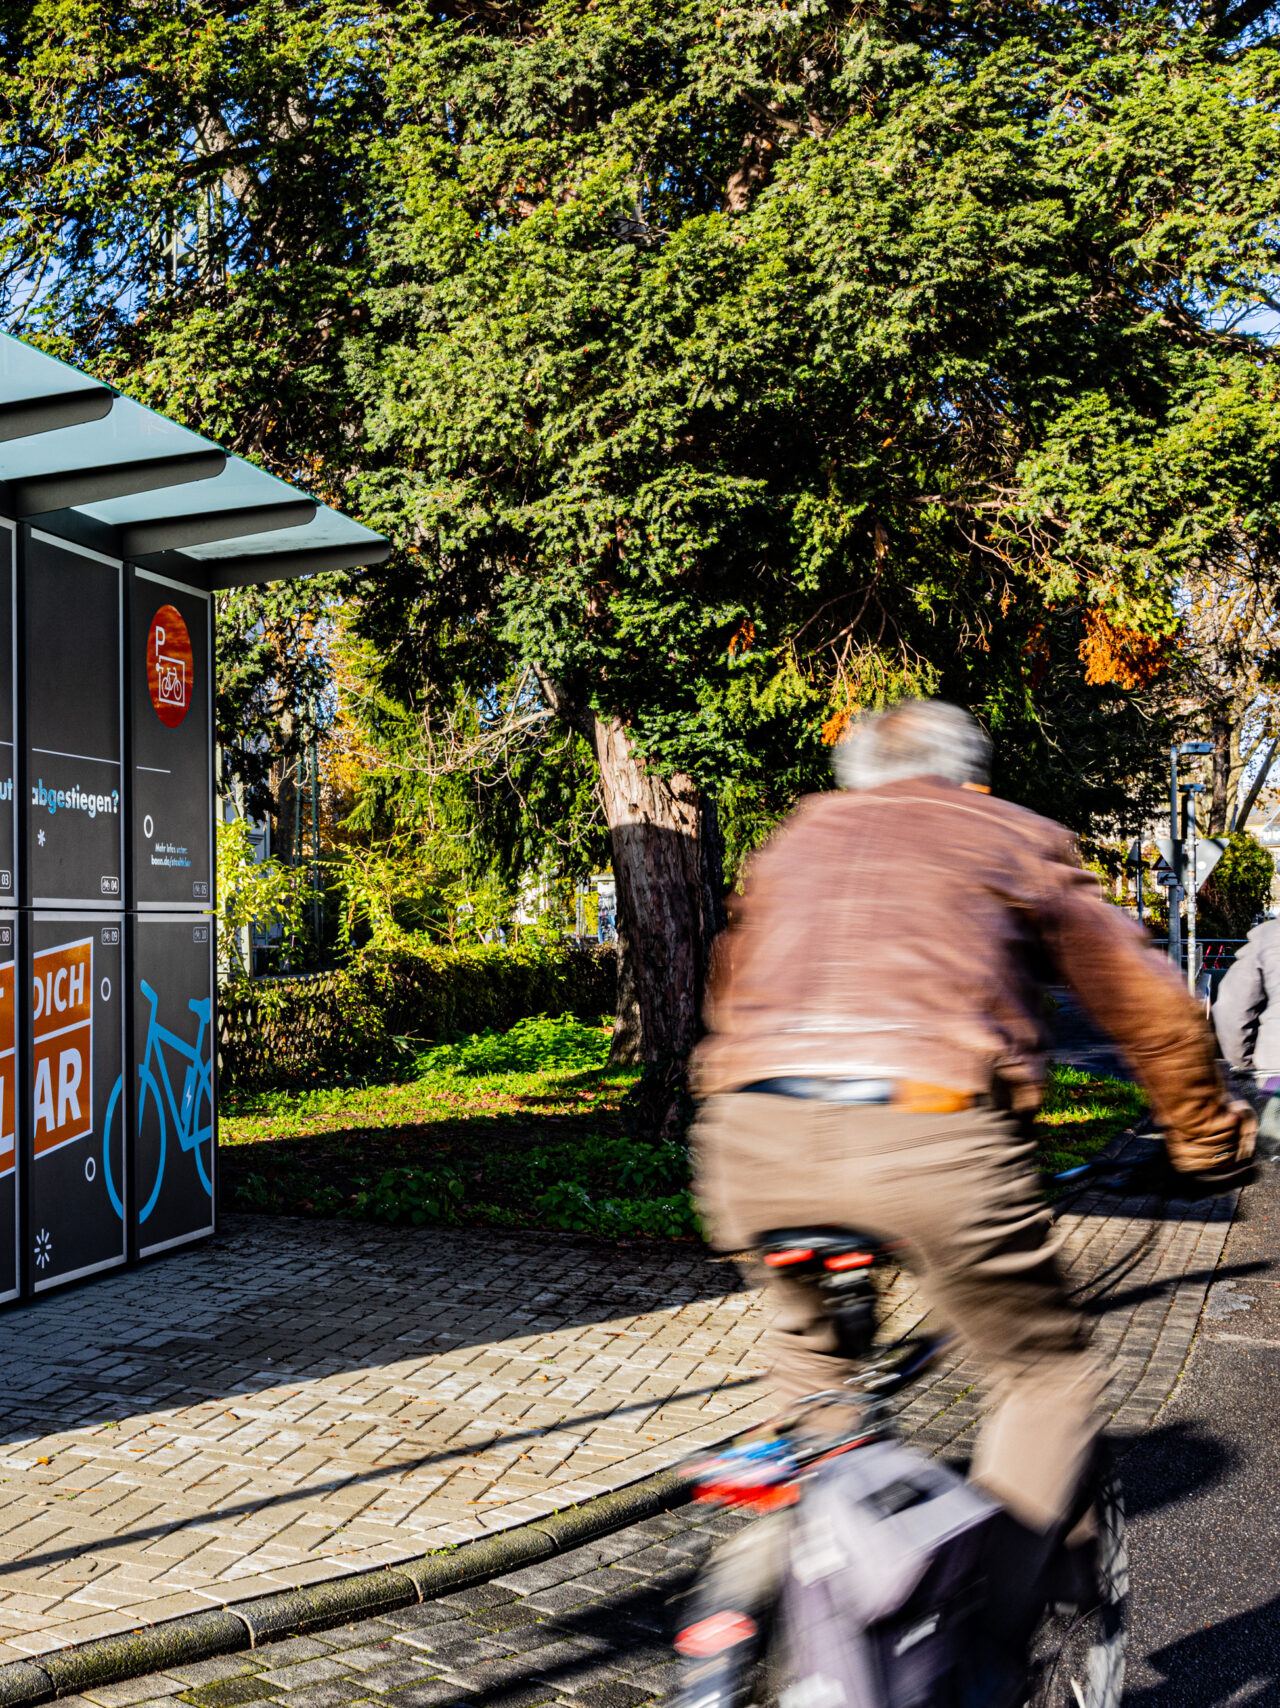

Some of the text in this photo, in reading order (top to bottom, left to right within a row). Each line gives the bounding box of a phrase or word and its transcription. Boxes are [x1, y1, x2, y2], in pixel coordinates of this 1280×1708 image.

[155, 625, 166, 656] P
[1, 874, 9, 886] 03
[110, 879, 118, 891] 04
[1, 932, 10, 943] 08
[111, 931, 118, 942] 09
